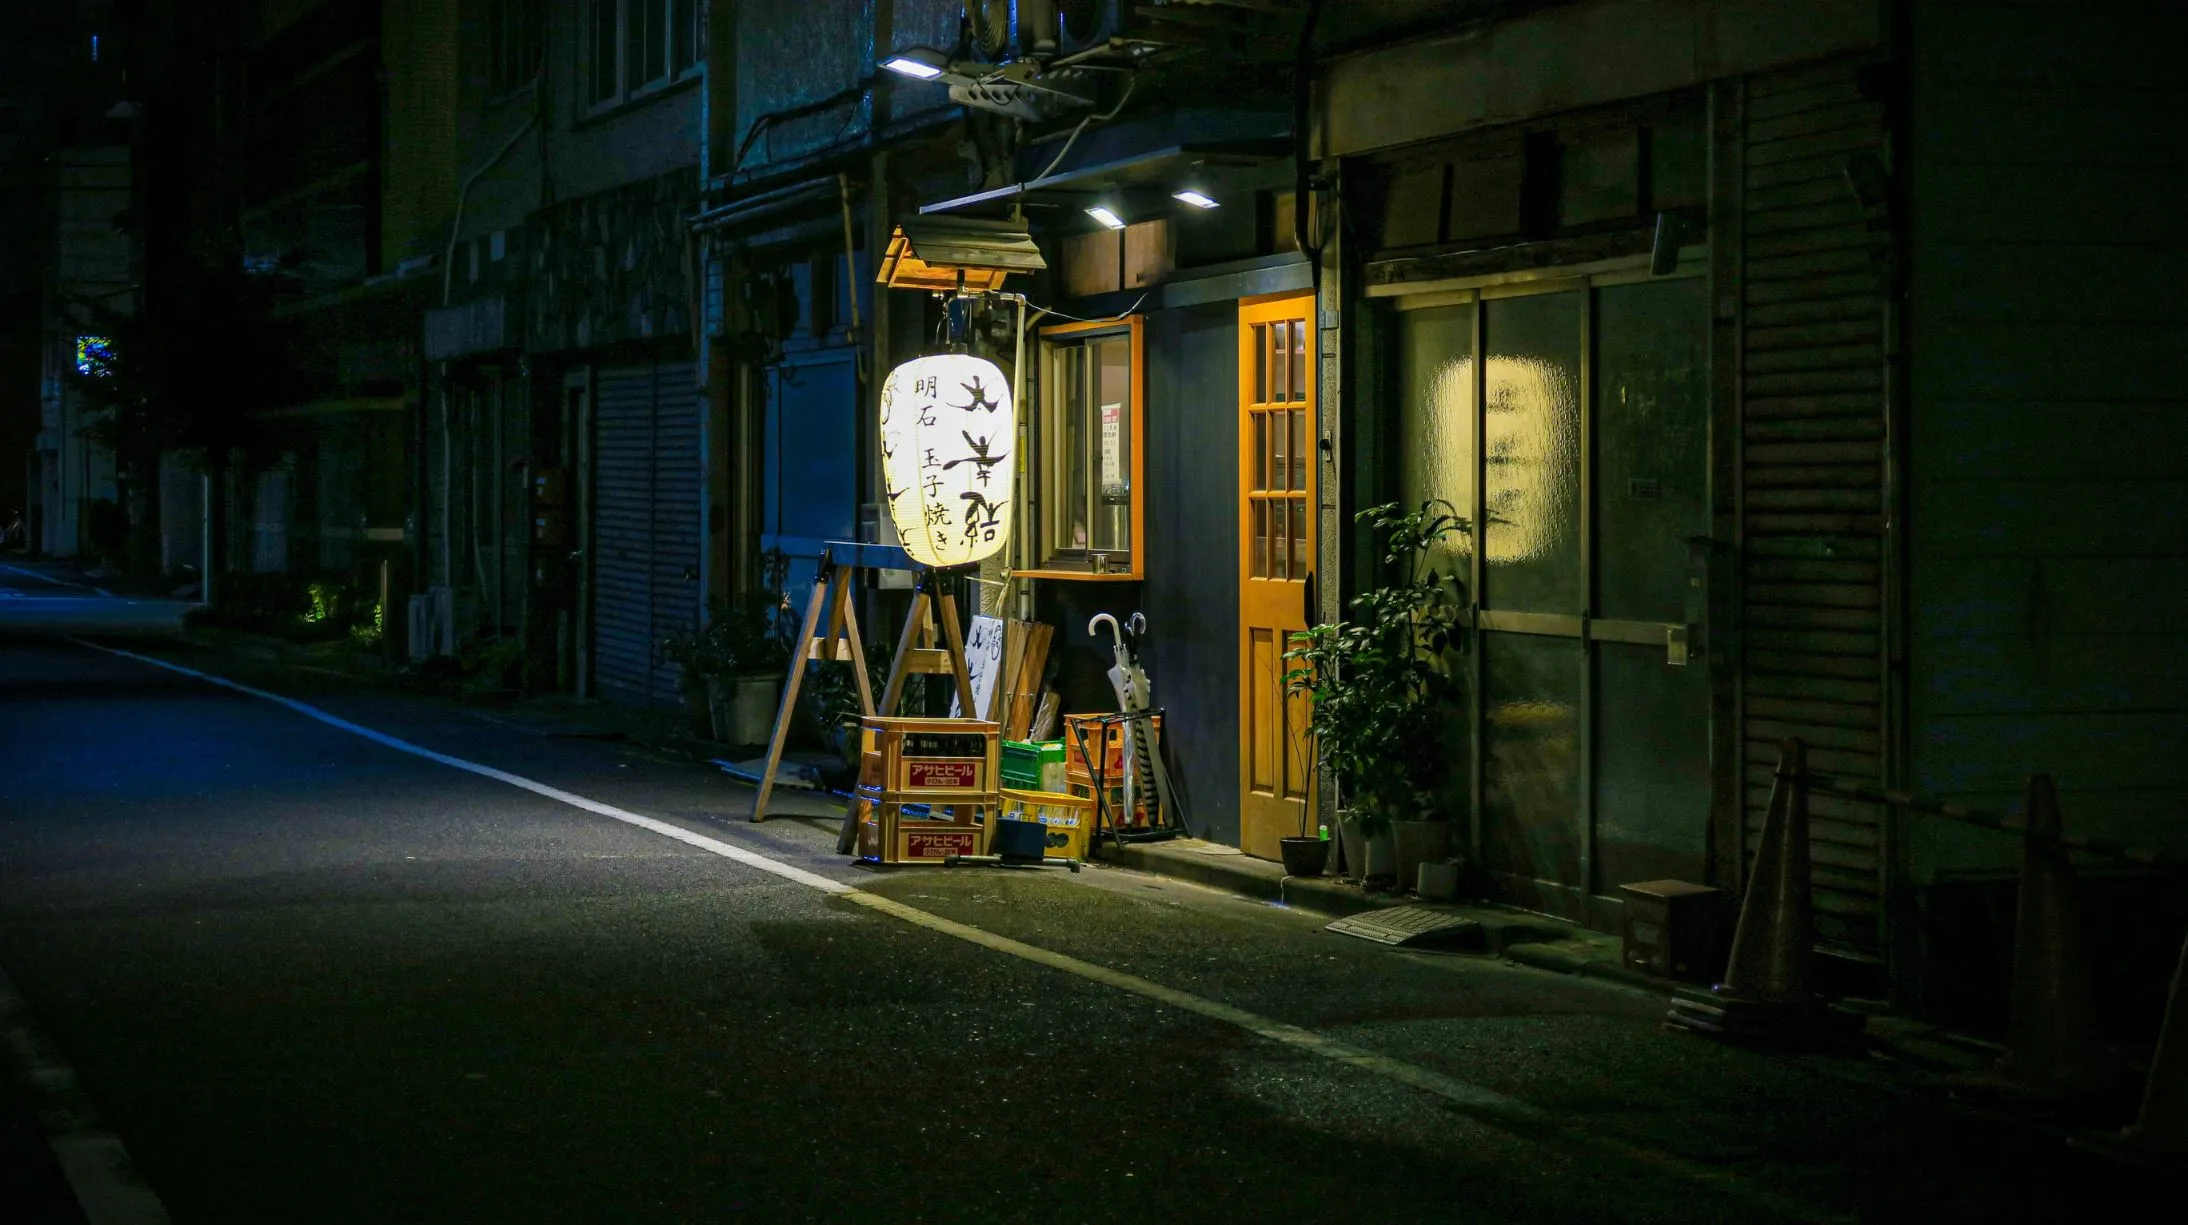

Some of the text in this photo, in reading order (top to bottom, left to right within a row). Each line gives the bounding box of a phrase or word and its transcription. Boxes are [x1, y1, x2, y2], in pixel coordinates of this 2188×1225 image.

[914, 376, 953, 551] 明石 玉子焼き
[912, 764, 973, 776] アサヒビール
[910, 835, 972, 847] アサヒビール
